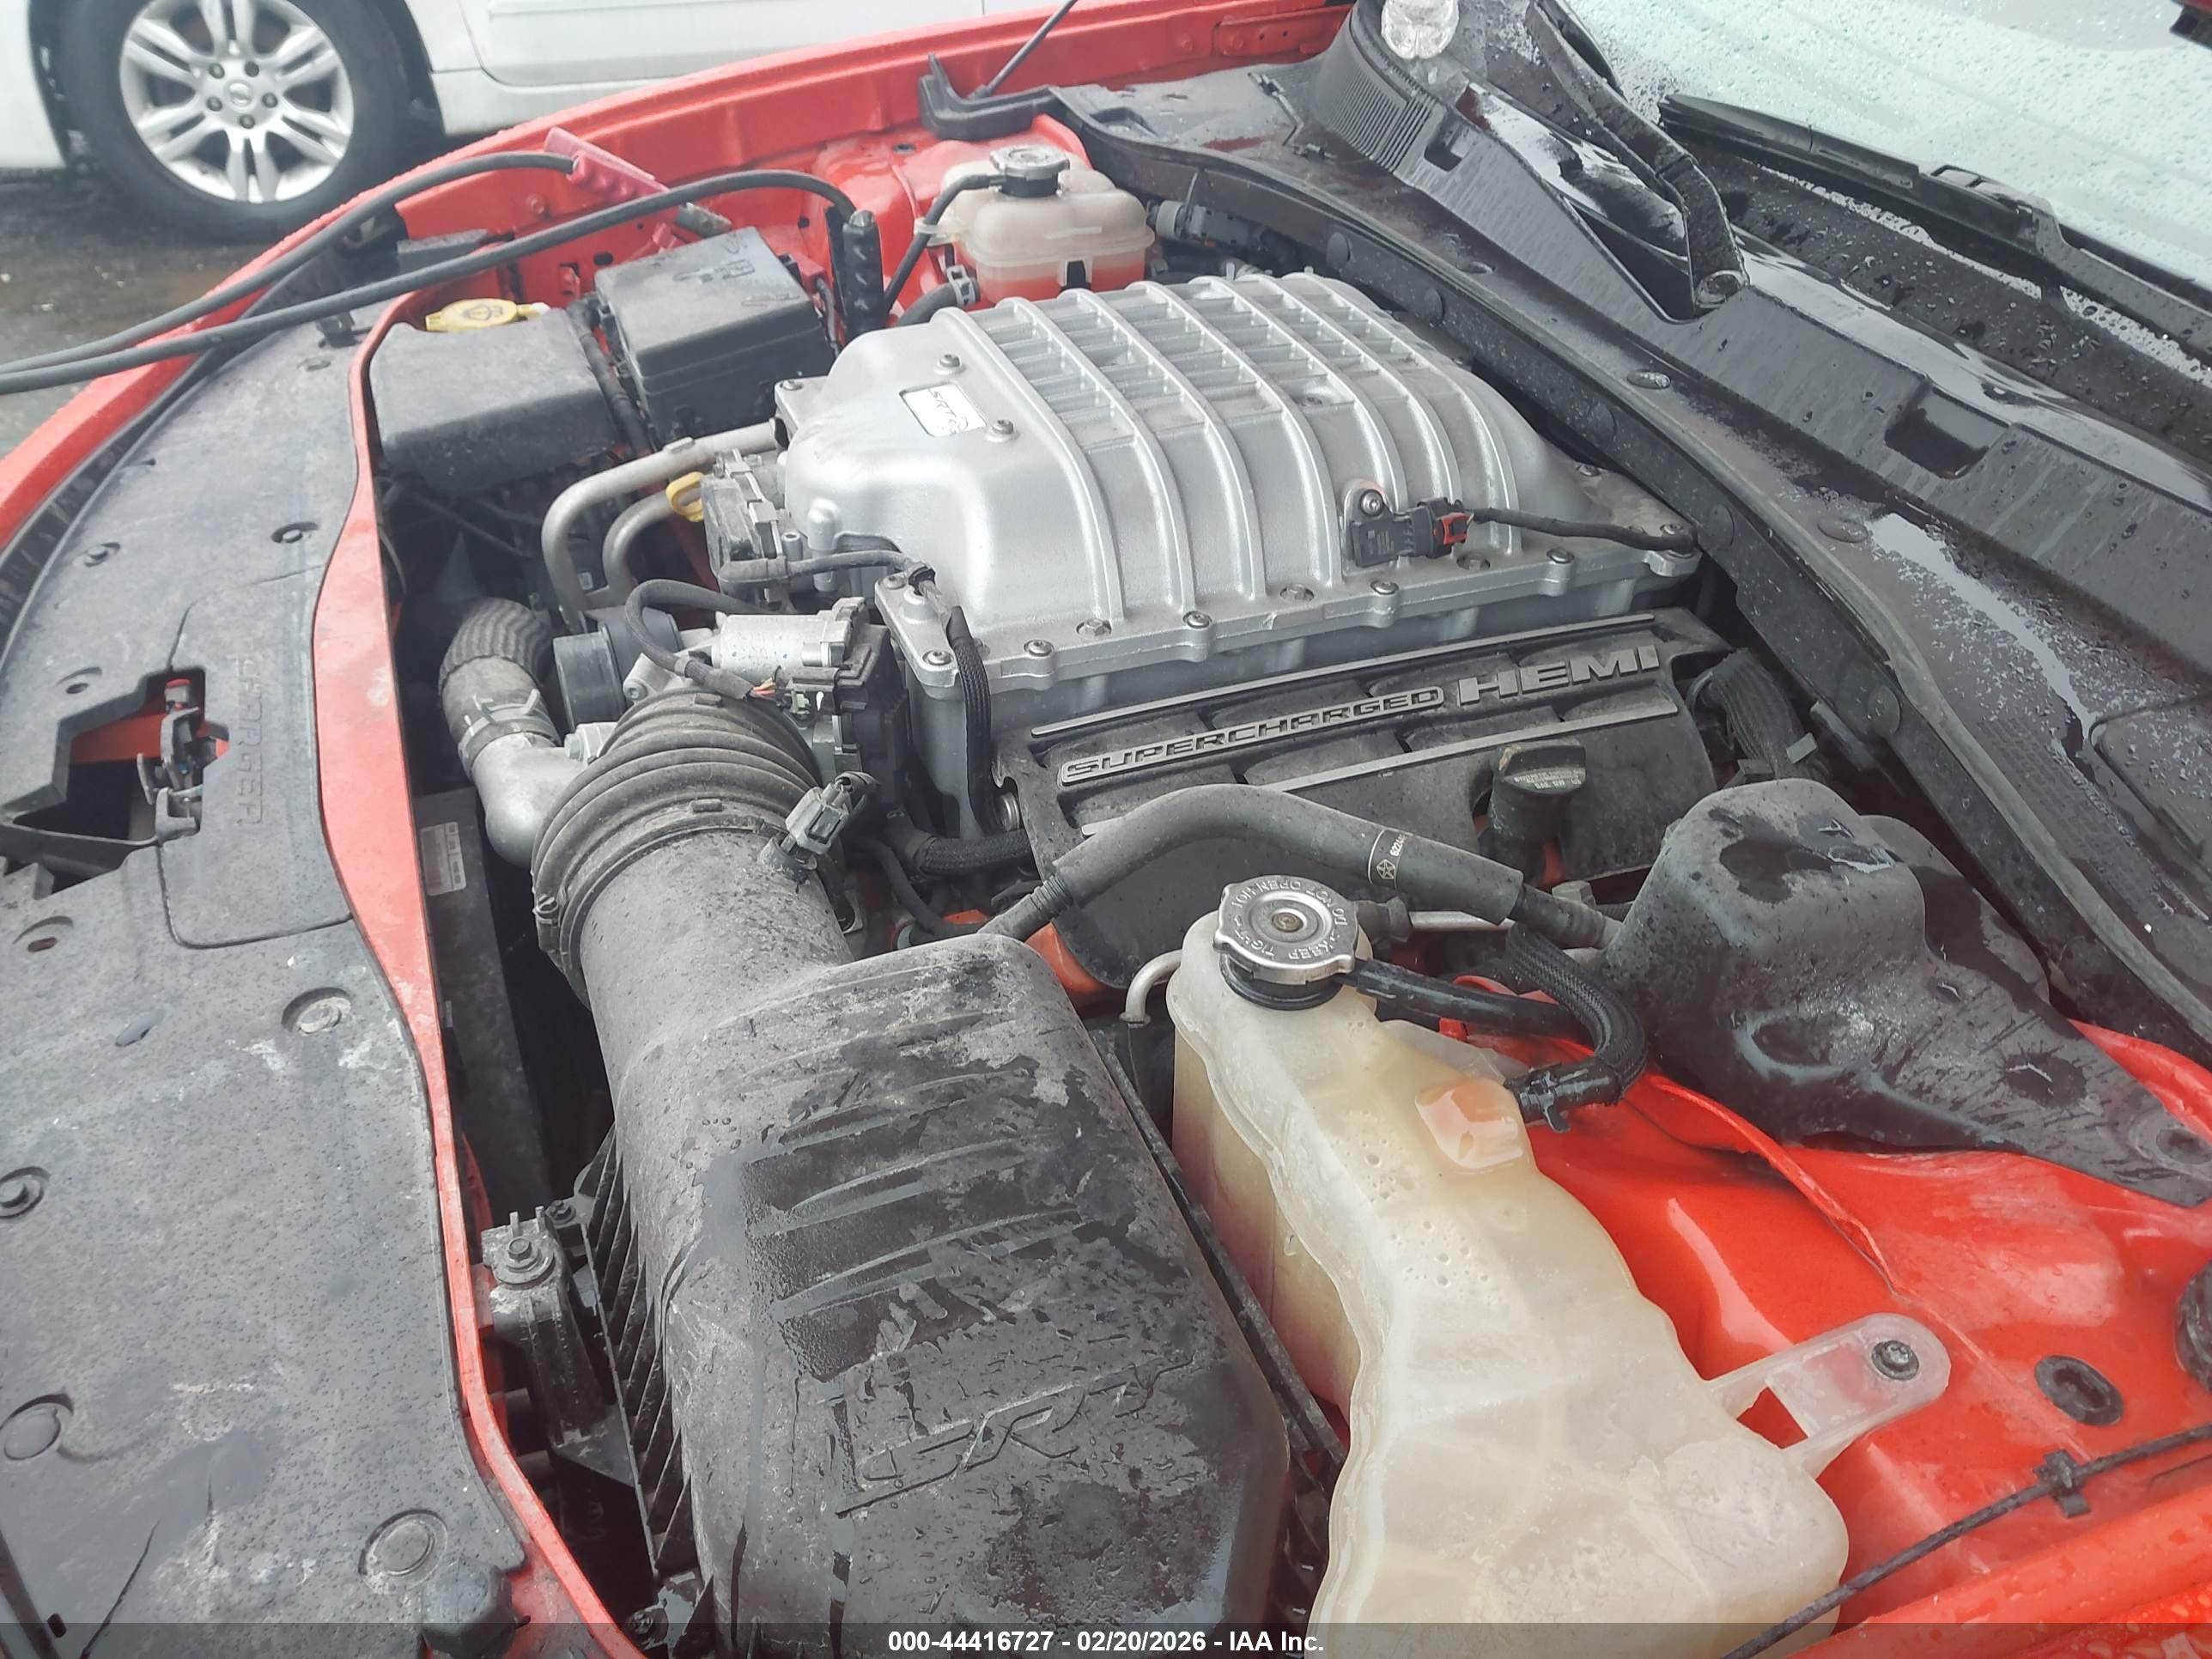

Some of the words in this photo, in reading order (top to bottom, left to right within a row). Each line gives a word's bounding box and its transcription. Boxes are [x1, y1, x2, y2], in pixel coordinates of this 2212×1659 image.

[927, 388, 958, 418] SRT
[1064, 689, 1442, 779] SUPERCHARGED
[1456, 645, 1660, 706] HEMI
[1256, 879, 1301, 893] OPEN
[1289, 941, 1333, 960] KEEP
[836, 1352, 1199, 1518] SRT
